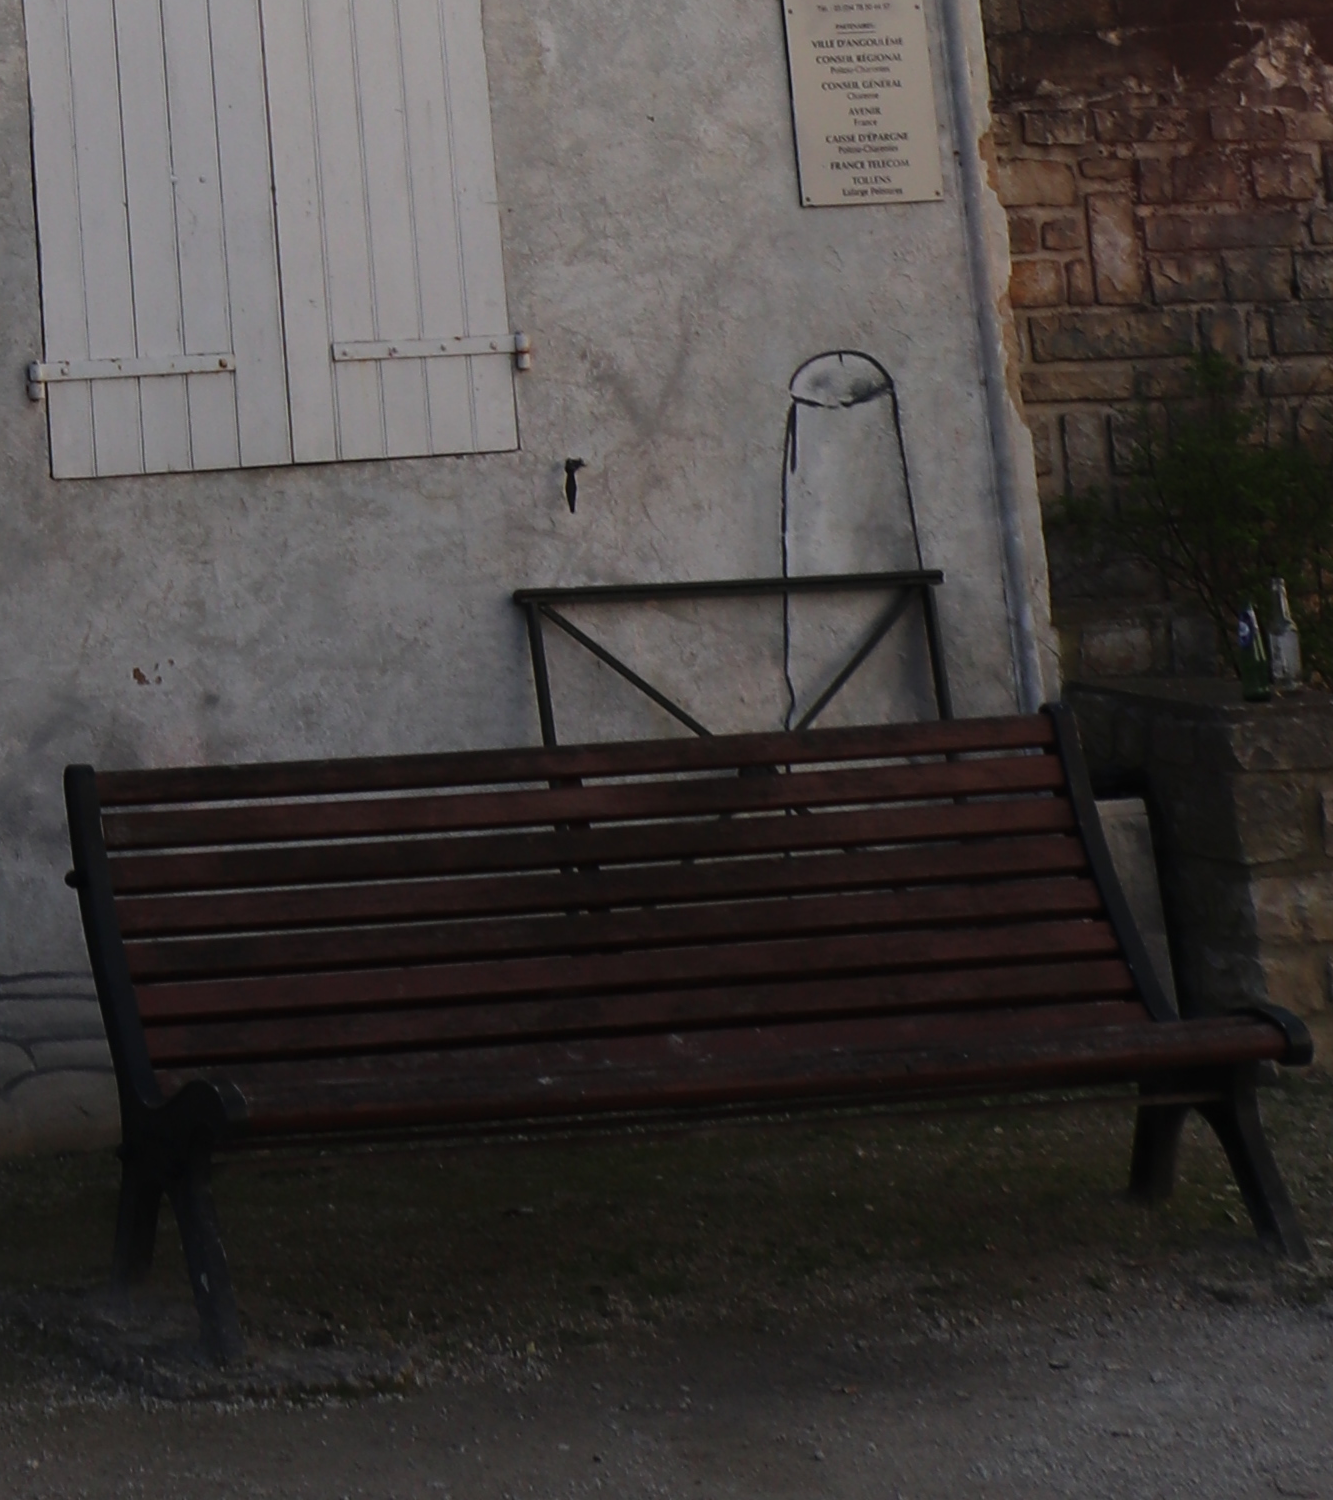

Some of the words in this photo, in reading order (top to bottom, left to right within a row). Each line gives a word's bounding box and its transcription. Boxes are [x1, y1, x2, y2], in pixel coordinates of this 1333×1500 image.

[811, 40, 835, 49] VILLE
[815, 55, 853, 64] CONSEIL
[856, 52, 903, 62] RÉGIONAL
[821, 81, 859, 91] CONSEIL
[861, 79, 902, 88] GÉNÉRAL
[848, 106, 882, 116] AVENIR
[853, 118, 878, 127] France
[825, 135, 855, 144] CAISSE
[858, 132, 909, 142] D'ÉPARGNE
[830, 161, 866, 171] FRANCE
[852, 176, 892, 185] TOLLENS
